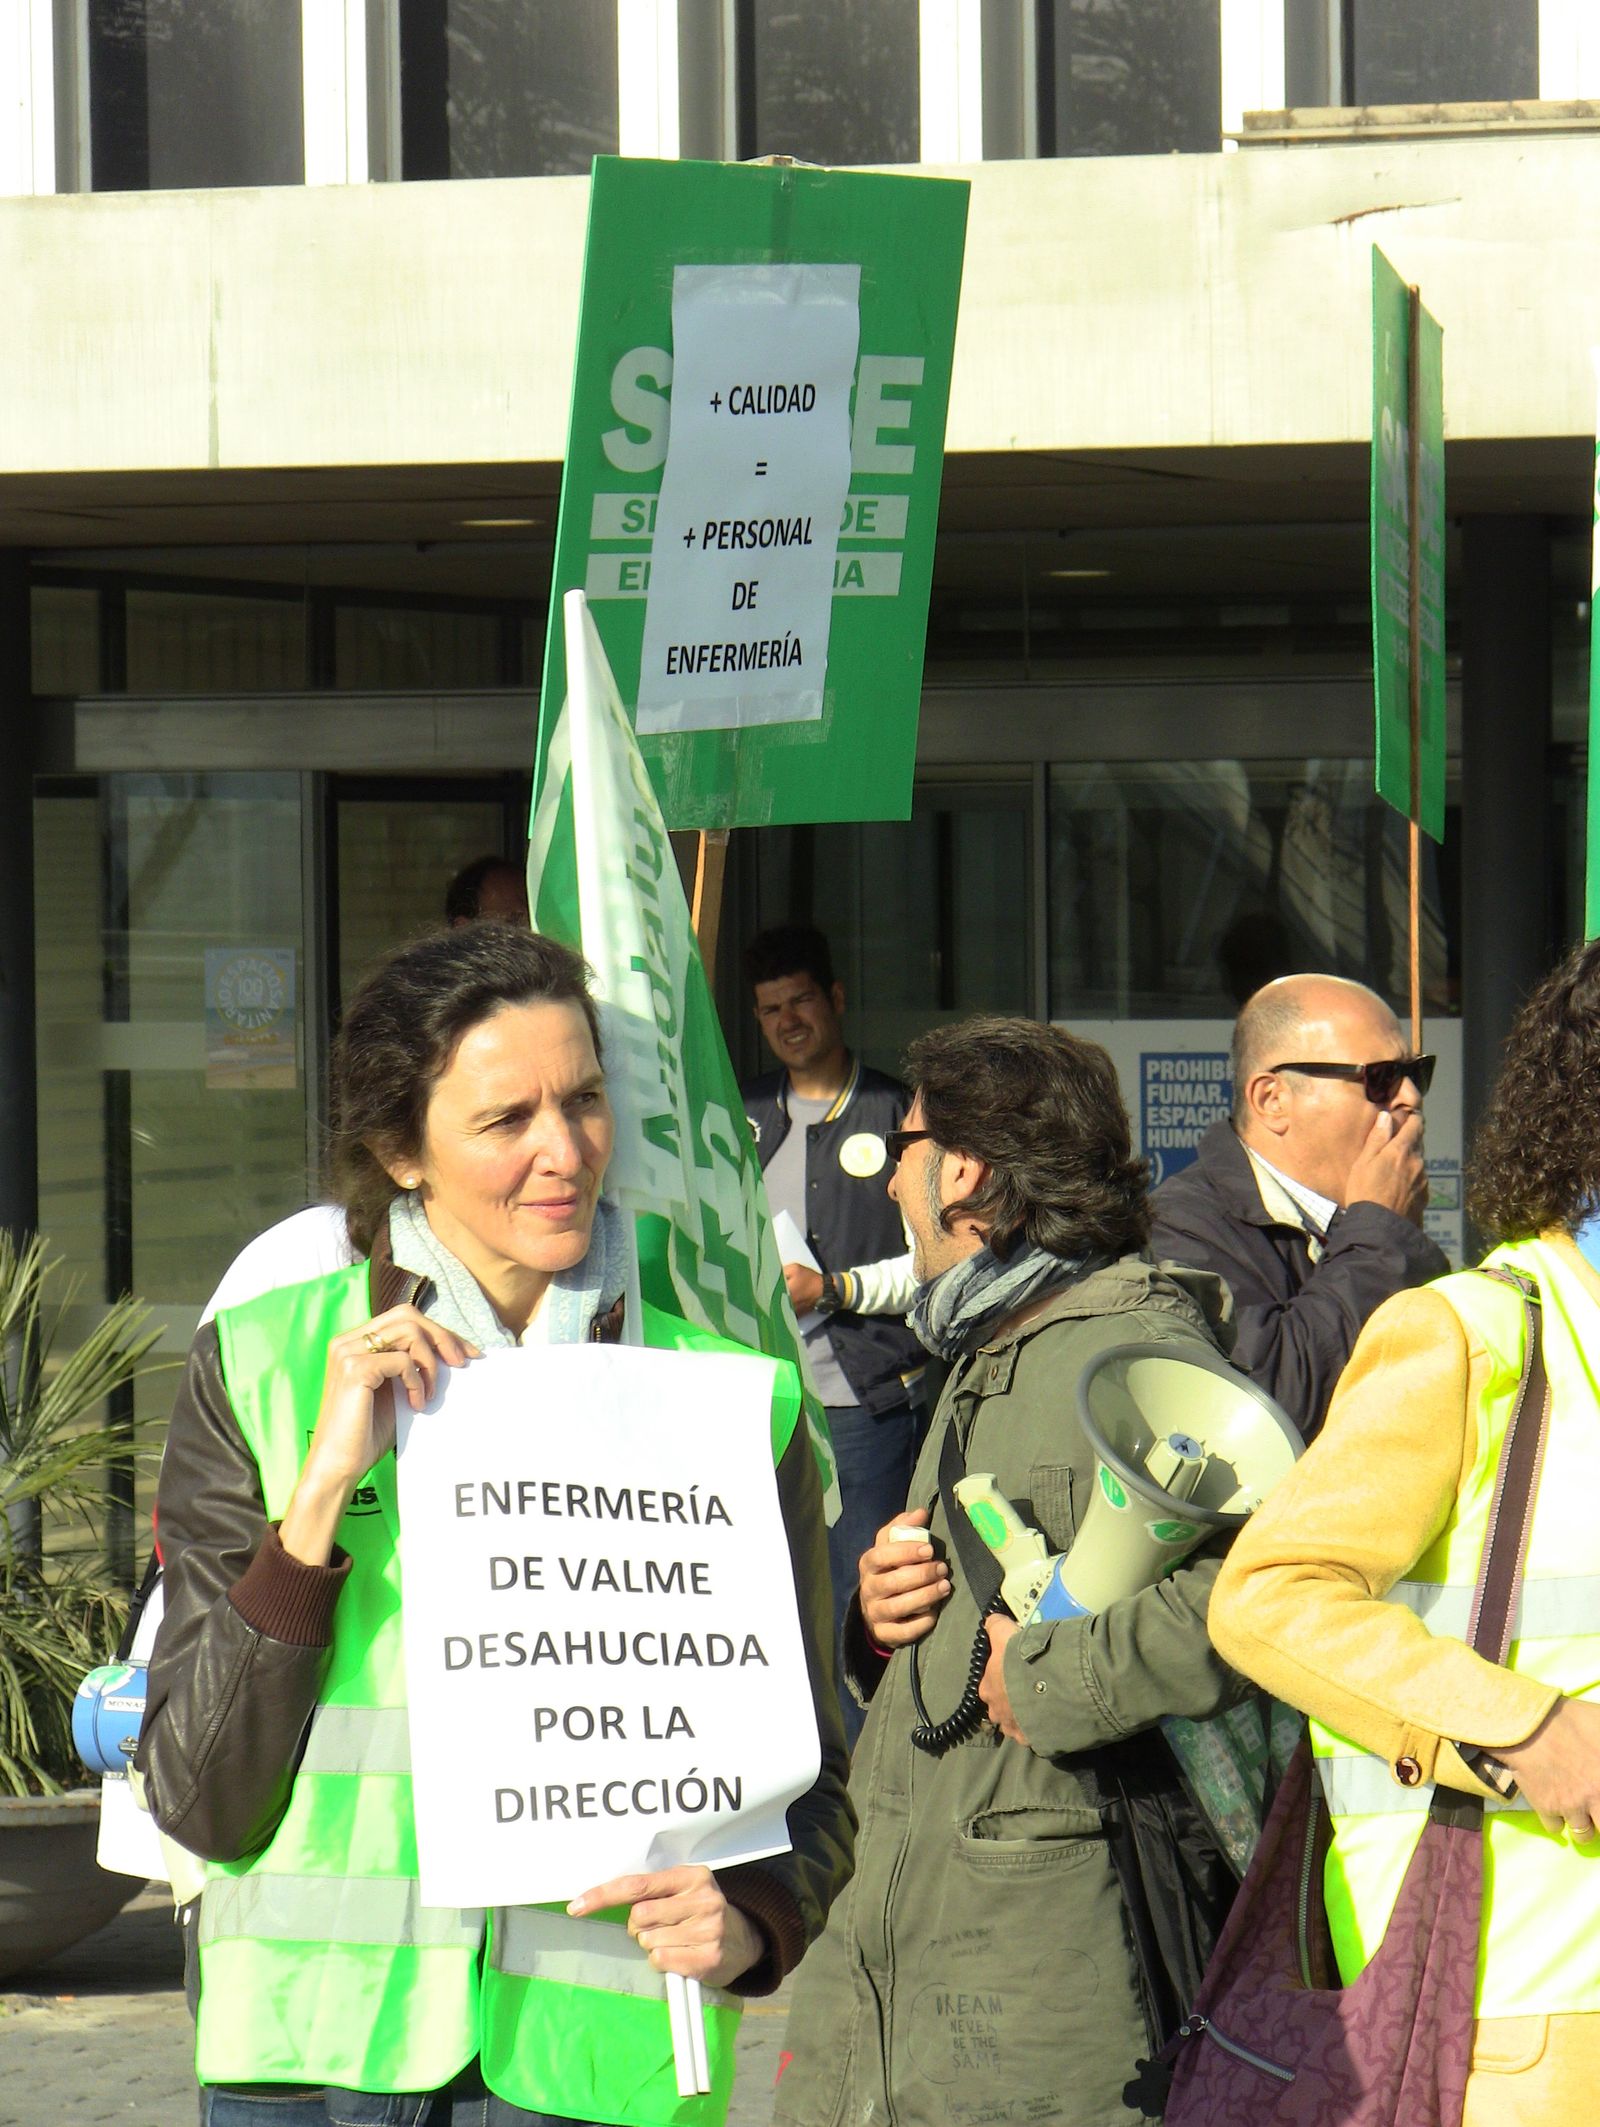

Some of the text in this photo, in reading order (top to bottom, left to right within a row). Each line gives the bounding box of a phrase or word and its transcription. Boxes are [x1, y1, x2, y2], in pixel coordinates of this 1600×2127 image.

[728, 383, 816, 416] CALIDAD
[702, 516, 813, 550] PERSONAL
[731, 580, 760, 611] DE
[666, 630, 803, 675] ENFERMERÍA
[1146, 1060, 1234, 1081] PROHIBI
[1146, 1082, 1229, 1105] FUMAR.
[455, 1481, 733, 1526] ENFERMERÍA
[488, 1556, 713, 1595] DE VALME
[443, 1630, 769, 1671] DESAHUCIADA
[533, 1705, 696, 1743] POR LA
[494, 1768, 743, 1823] DIRECCIÓN
